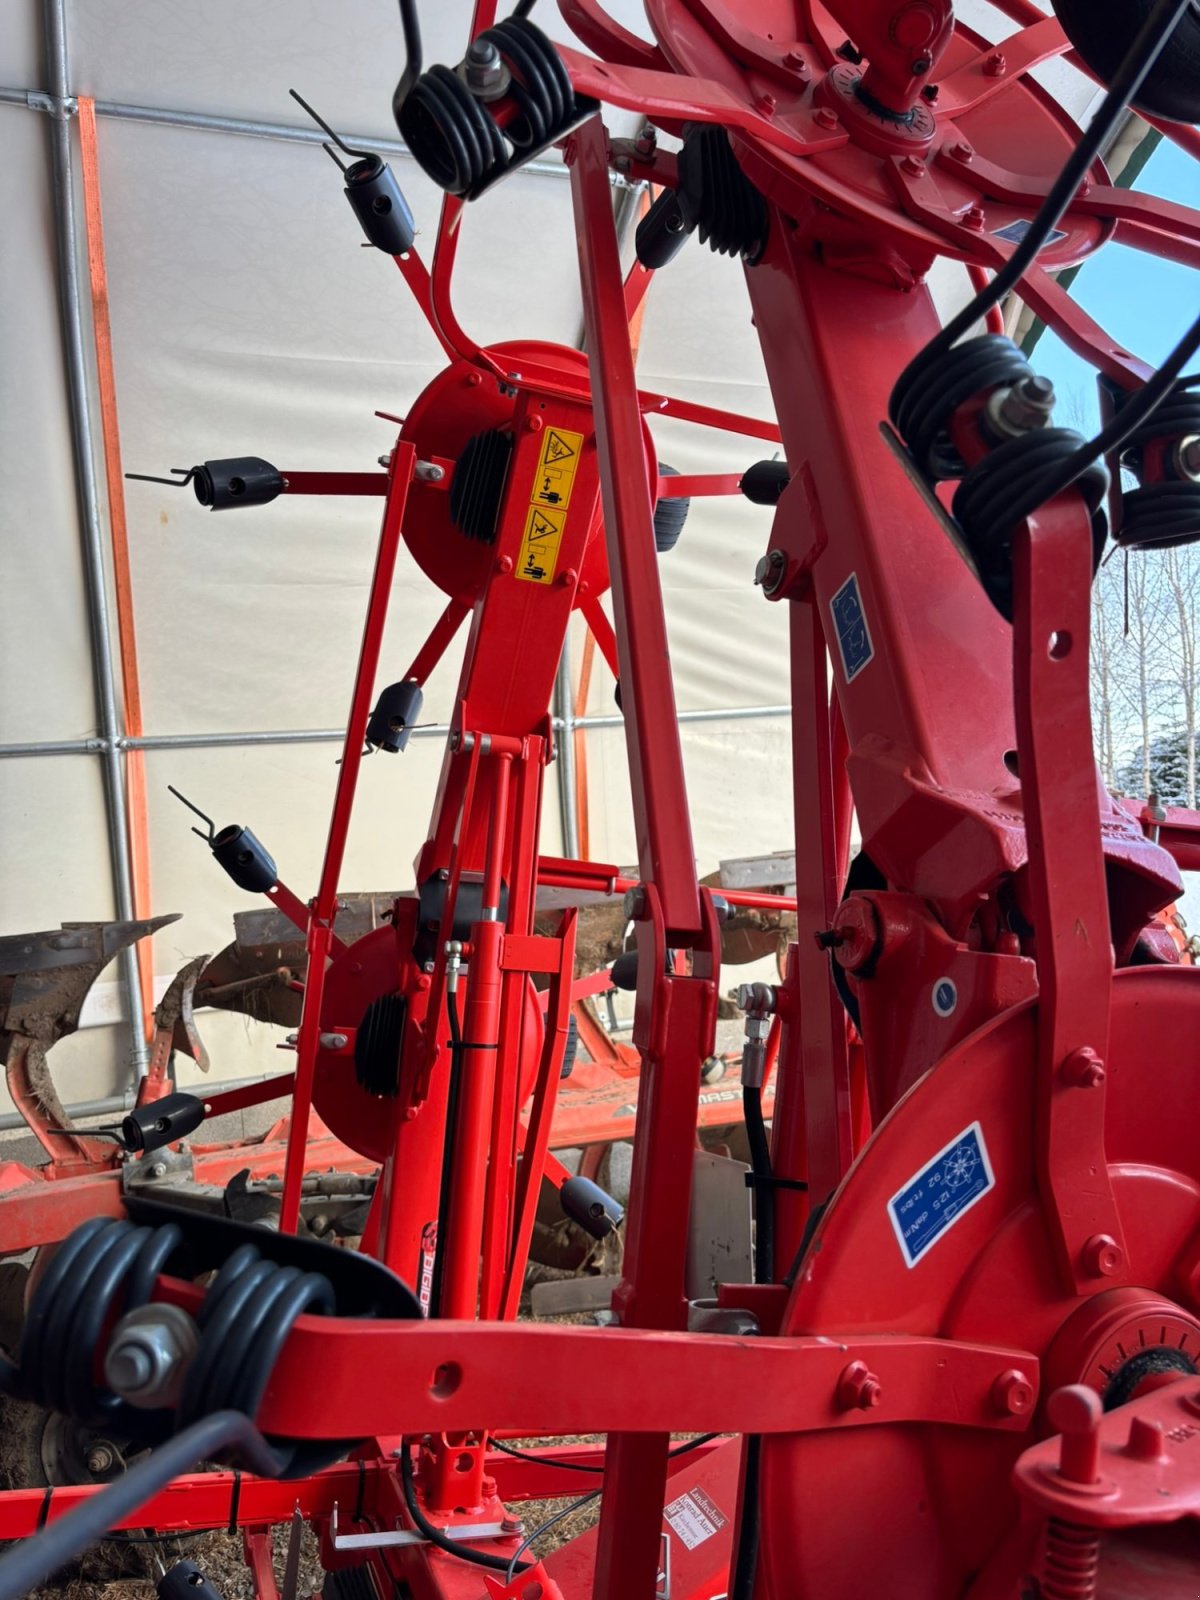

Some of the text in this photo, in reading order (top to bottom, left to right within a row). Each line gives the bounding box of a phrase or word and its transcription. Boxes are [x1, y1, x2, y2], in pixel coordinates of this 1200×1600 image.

[928, 1173, 941, 1188] 92
[680, 1496, 702, 1519] Konrad
[690, 1487, 725, 1529] Landtechnik
